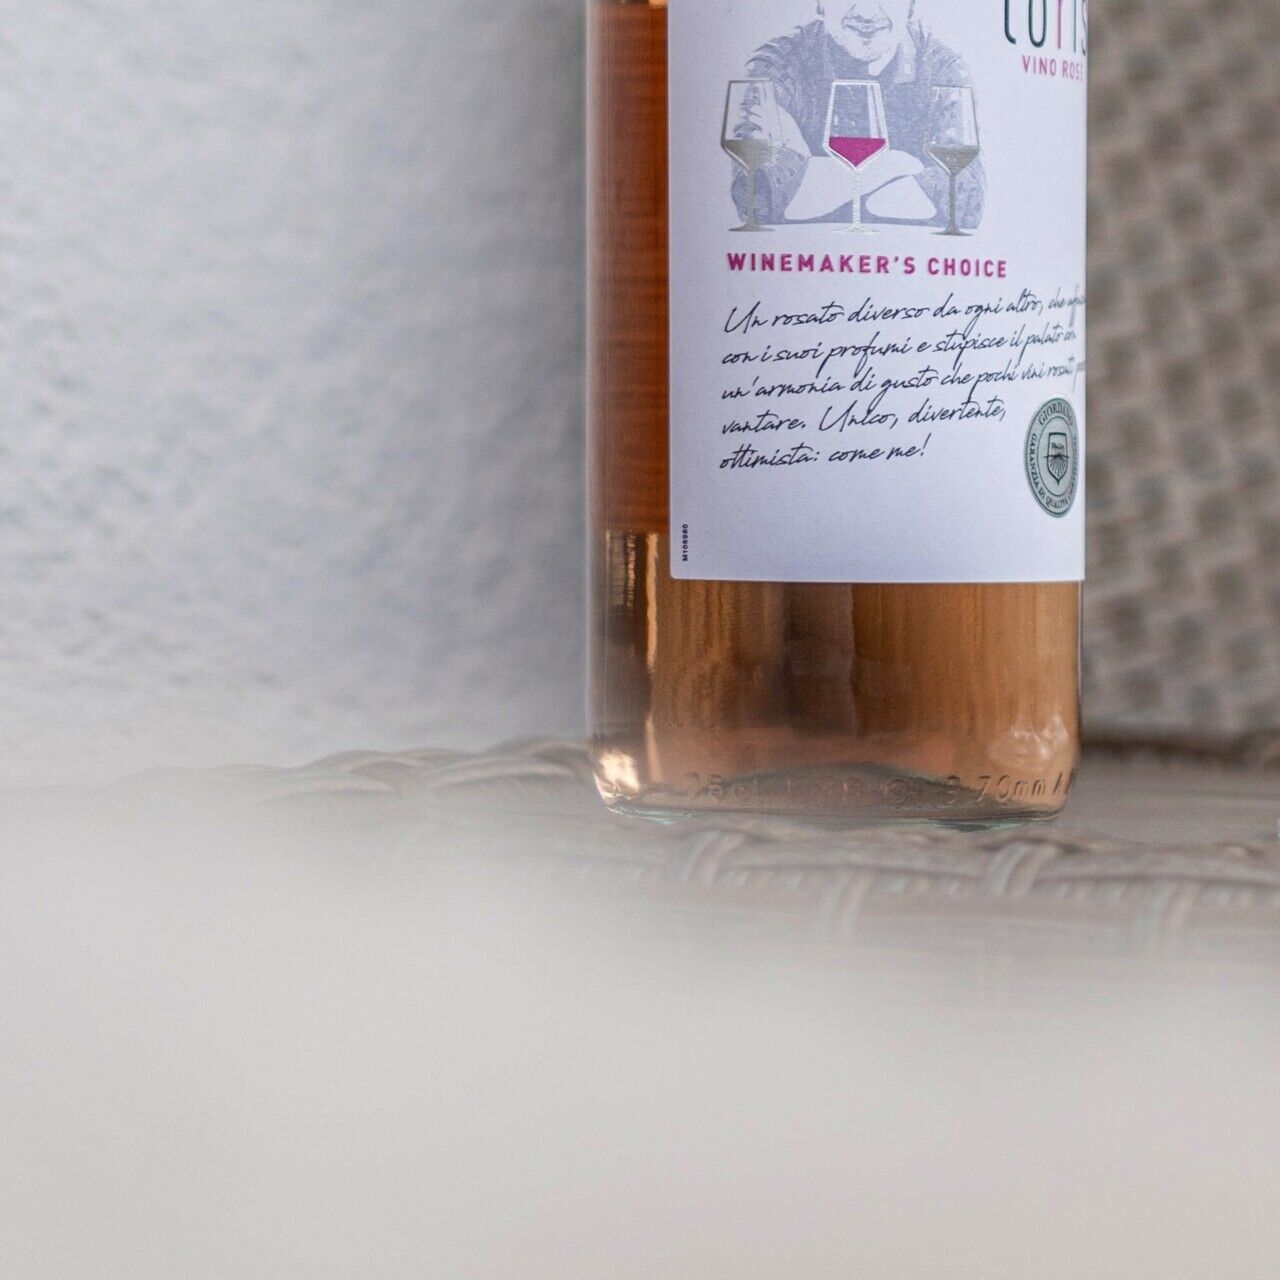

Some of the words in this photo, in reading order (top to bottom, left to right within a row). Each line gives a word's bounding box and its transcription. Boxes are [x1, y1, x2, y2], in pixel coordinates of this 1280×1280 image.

[1022, 54, 1057, 76] VINO
[726, 252, 916, 274] WINEMAKER'S
[928, 257, 1007, 278] CHOICE
[724, 301, 769, 334] Un
[771, 301, 845, 326] rosato
[847, 297, 930, 323] diverso
[933, 293, 961, 318] da
[965, 297, 1002, 341] ogni
[722, 351, 758, 365] con
[773, 342, 825, 362] suoi
[816, 331, 912, 379] profumi
[917, 341, 932, 352] e
[932, 329, 1008, 370] stupisce
[1010, 323, 1026, 348] il
[722, 375, 845, 399] un'armonia
[850, 366, 878, 392] di
[868, 365, 939, 415] gusto
[940, 362, 976, 385] che
[968, 359, 1018, 403] pochi
[722, 409, 806, 435] vantare.
[908, 395, 1006, 424] divertente,
[719, 442, 820, 469] ottimista:
[828, 447, 885, 463] come
[886, 432, 932, 461] me!
